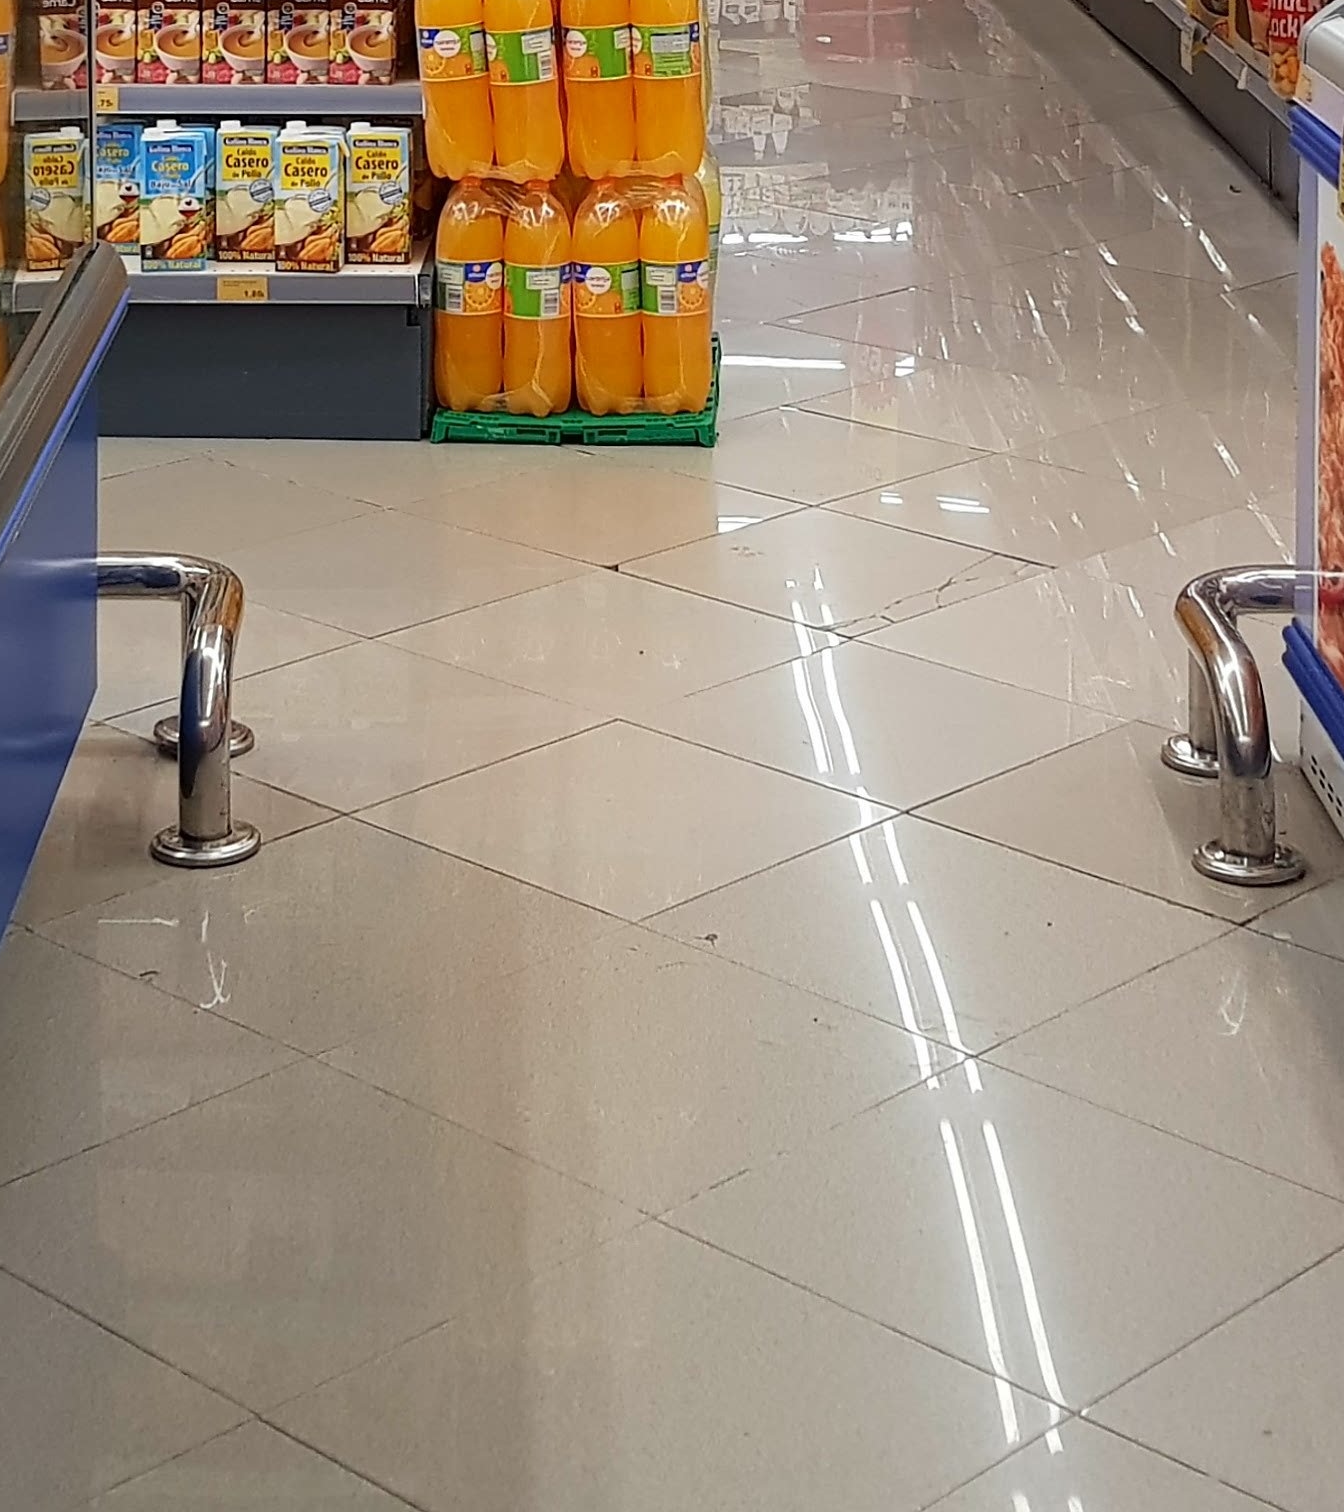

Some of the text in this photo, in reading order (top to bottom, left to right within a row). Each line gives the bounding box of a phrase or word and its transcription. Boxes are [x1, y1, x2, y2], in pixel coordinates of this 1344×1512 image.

[225, 155, 270, 169] Casero
[355, 157, 399, 171] Casero
[284, 165, 328, 179] Casero
